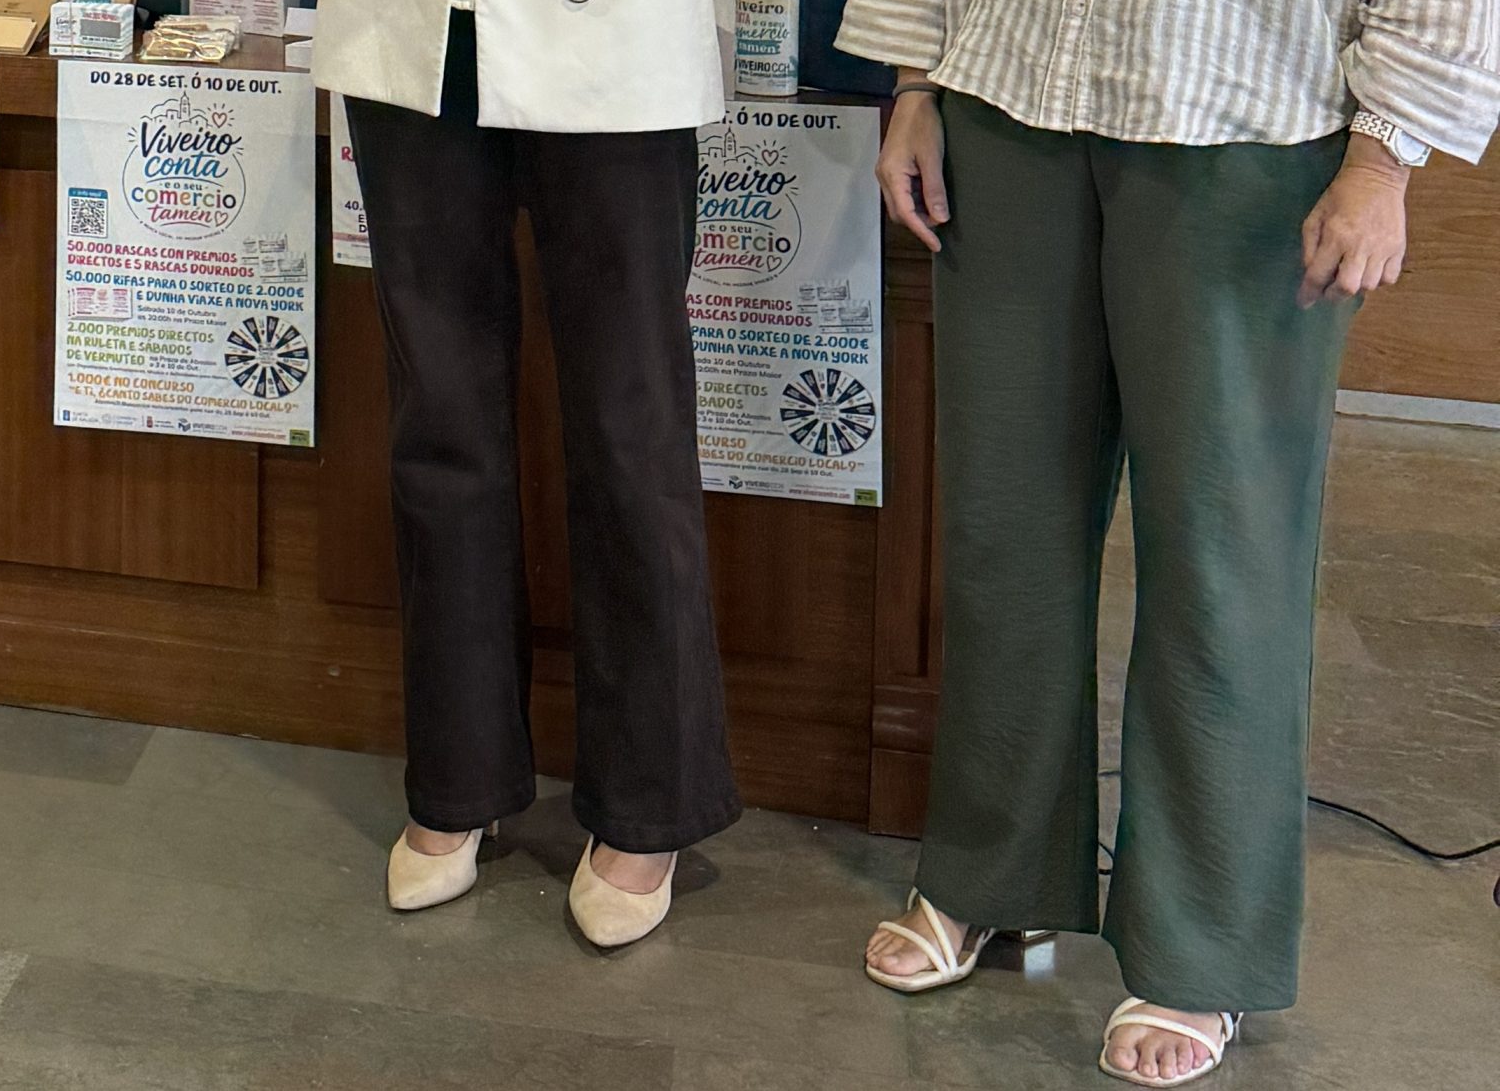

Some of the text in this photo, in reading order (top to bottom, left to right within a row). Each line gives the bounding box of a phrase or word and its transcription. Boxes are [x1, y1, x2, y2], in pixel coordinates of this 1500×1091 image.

[90, 71, 283, 95] DO 28 DE SET. Ó 10 DE OUT.
[737, 106, 749, 126] Ó
[752, 112, 774, 128] 10
[777, 113, 800, 129] DE
[803, 114, 841, 130] OUT.
[141, 122, 243, 158] Viveiro
[145, 151, 229, 178] conta
[131, 187, 236, 209] comercio
[147, 204, 213, 223] tamén
[67, 240, 113, 254] 50.000
[115, 245, 159, 258] RASCAS
[160, 247, 185, 260] CON
[693, 248, 765, 268] tamén
[125, 259, 132, 269] E
[134, 259, 142, 270] 5
[144, 260, 189, 274] RASCAS
[190, 264, 255, 278] DOURADOS
[66, 270, 111, 284] 50.000
[147, 277, 177, 289] PARA
[179, 279, 188, 290] O
[190, 281, 235, 294] SORTEO
[237, 283, 253, 296] DE
[256, 285, 305, 299] 2.000€
[136, 290, 144, 301] E
[146, 291, 185, 304] DUNHA
[225, 297, 234, 308] A
[235, 298, 269, 311] NOVA
[270, 300, 305, 312] YORK
[705, 294, 733, 308] CON
[687, 308, 813, 327] RASCAS DOURADOS
[67, 322, 104, 335] 2.000
[691, 326, 870, 350] PARA O SORTEO DE 2.000€
[84, 337, 127, 351] RULETA
[138, 339, 193, 357] SÁBADOS
[780, 348, 790, 359] A
[791, 349, 829, 362] NOVA
[831, 351, 869, 365] YORK
[66, 349, 146, 366] DE VERMUTEO
[132, 378, 195, 393] CONCURSO
[142, 391, 176, 404] SABES
[177, 394, 192, 405] DO
[193, 395, 248, 410] COMERCIO
[699, 396, 744, 409] BADOS
[728, 451, 745, 461] DO
[746, 452, 807, 468] COMERCIO
